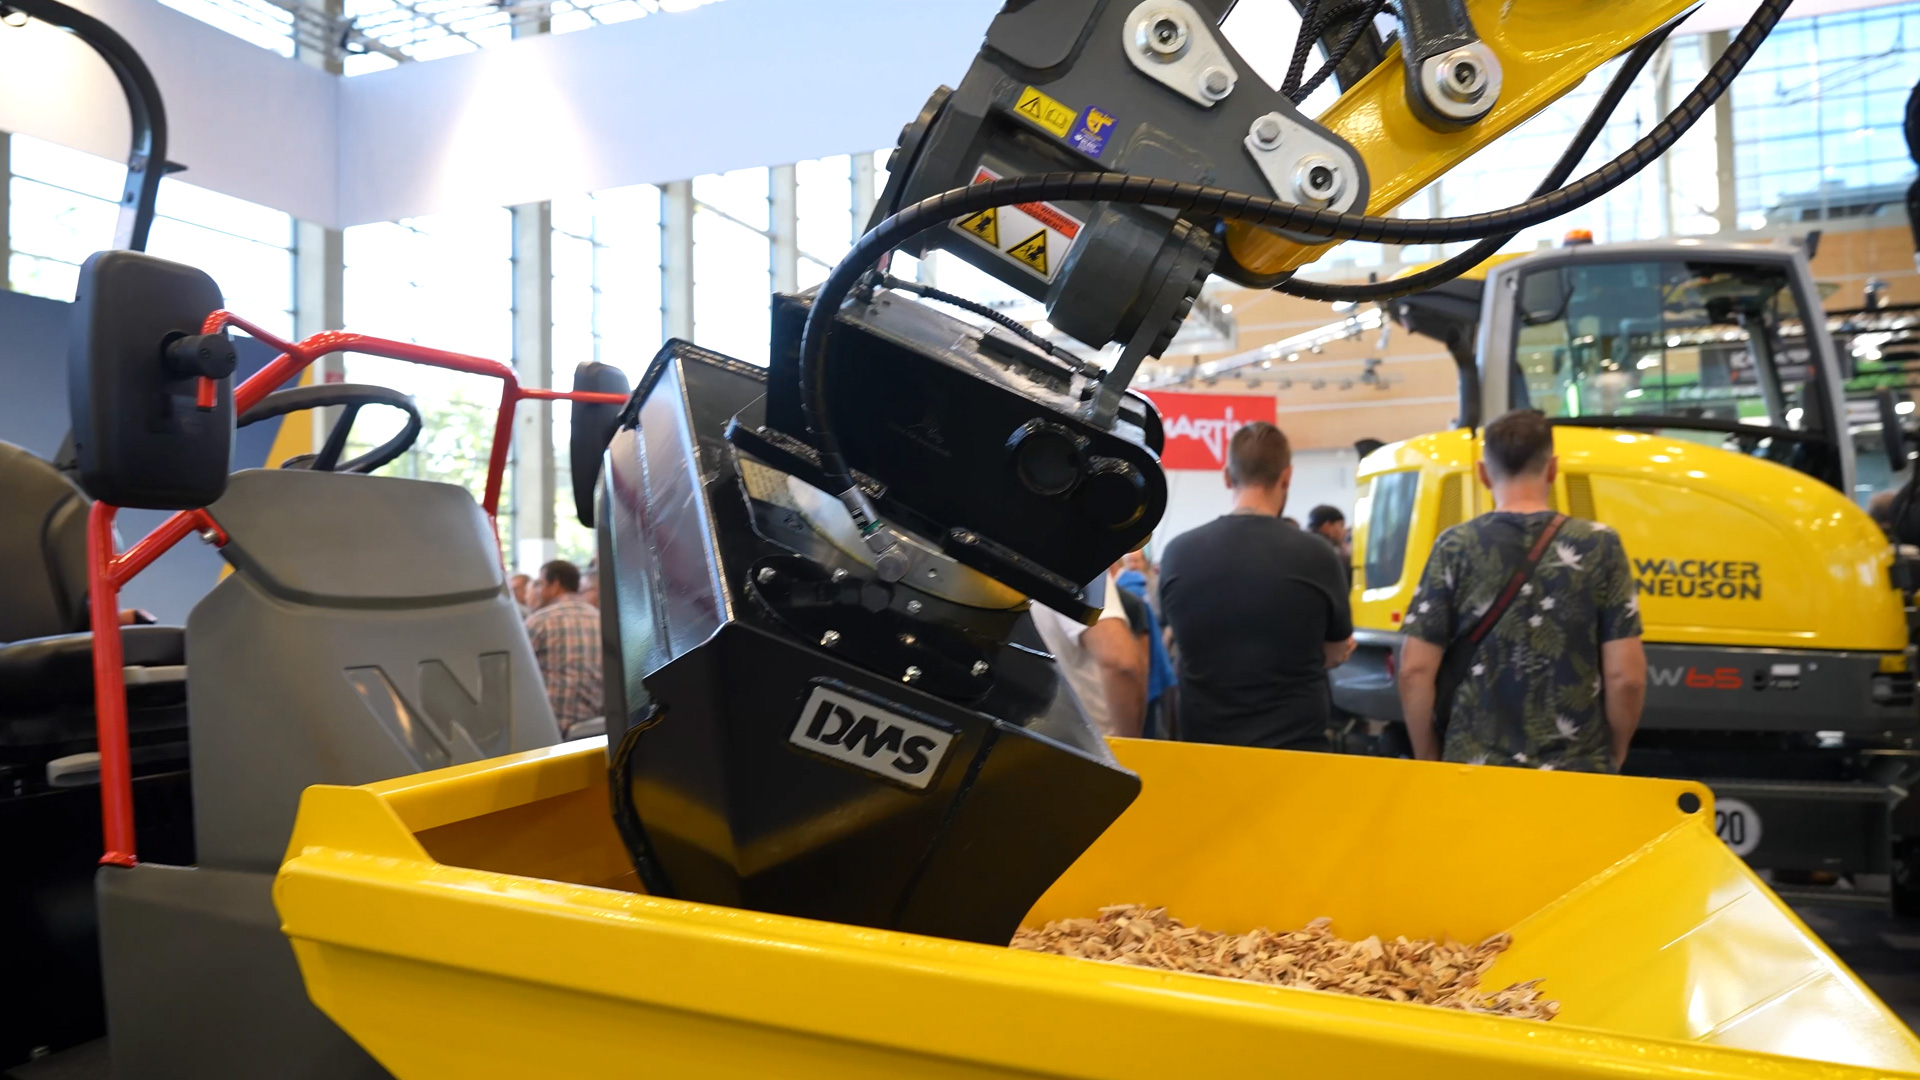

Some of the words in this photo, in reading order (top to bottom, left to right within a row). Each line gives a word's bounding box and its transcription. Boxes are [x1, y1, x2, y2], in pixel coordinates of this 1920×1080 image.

[1633, 558, 1761, 579] WACKER
[1635, 578, 1762, 600] NEUSON
[805, 699, 938, 774] DMS
[1715, 810, 1745, 845] 20
